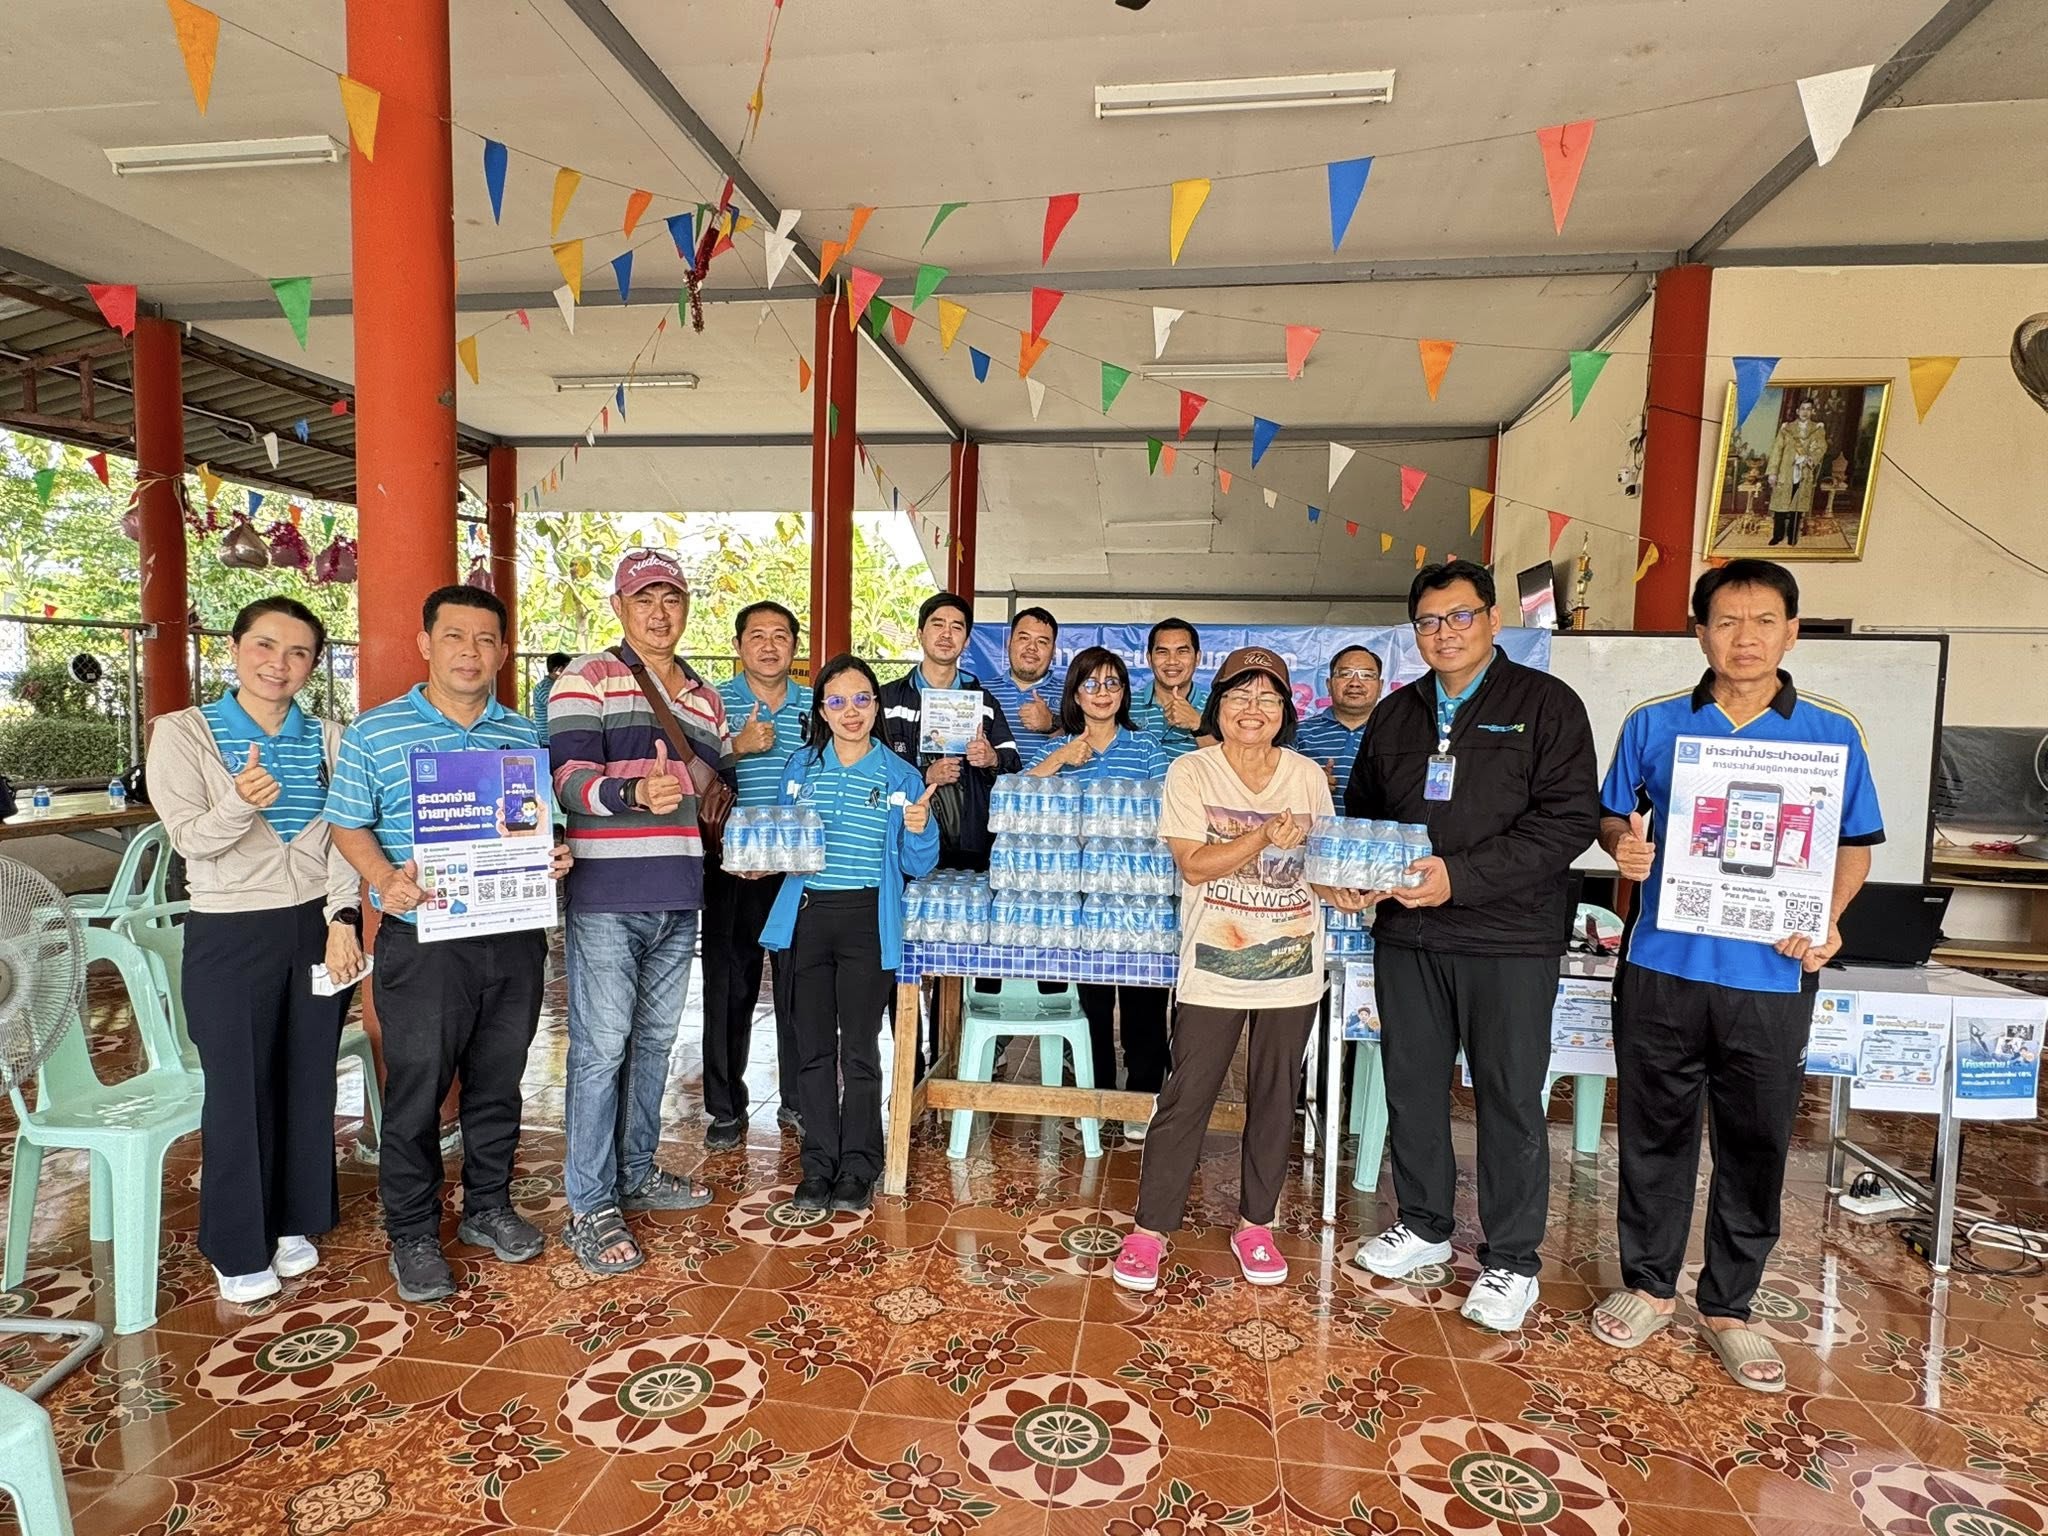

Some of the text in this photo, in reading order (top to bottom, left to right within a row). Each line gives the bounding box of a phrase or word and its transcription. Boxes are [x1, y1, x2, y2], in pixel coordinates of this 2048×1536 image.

[1705, 744, 1840, 764] ชำระค่าน้ำประปาออนไลน์
